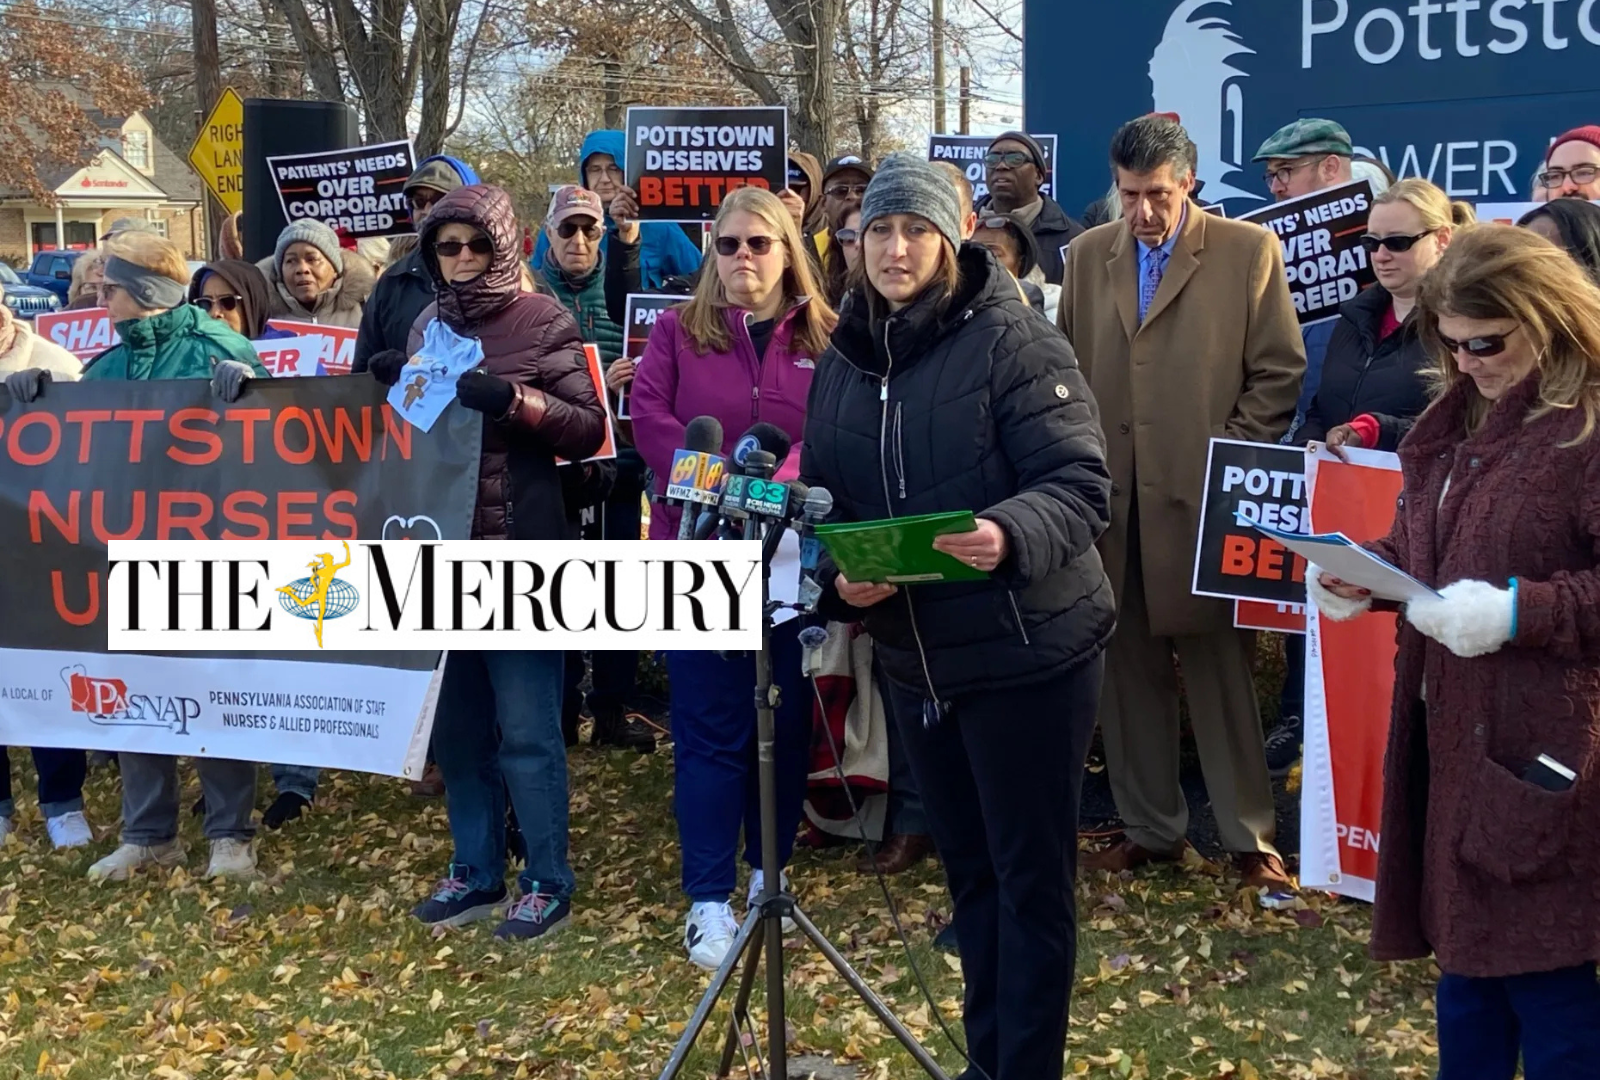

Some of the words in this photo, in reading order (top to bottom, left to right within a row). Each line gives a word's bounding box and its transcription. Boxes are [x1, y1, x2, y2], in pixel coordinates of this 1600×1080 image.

[636, 126, 774, 147] POTTSTOWN
[277, 161, 351, 180] PATIENTS'
[355, 152, 407, 173] NEEDS
[646, 150, 763, 171] DESERVES
[93, 179, 128, 188] Santander
[317, 176, 374, 197] OVER
[289, 193, 407, 217] CORPORAT
[1304, 193, 1368, 227] NEEDS
[0, 406, 412, 466] OTTSTOWN
[672, 455, 697, 484] 69
[669, 485, 691, 498] WFMZ
[28, 490, 358, 544] NURSES
[2, 688, 8, 698] A
[10, 687, 39, 700] LOCAL
[41, 689, 53, 700] OF
[209, 690, 291, 708] PENNSYLVANIA
[293, 695, 352, 713] ASSOCIATION
[354, 699, 364, 713] OF
[366, 700, 386, 716] STAFF
[90, 680, 201, 735] PASNAP
[222, 712, 267, 730] NURSES
[269, 716, 276, 729] &
[278, 717, 311, 733] ALLIED
[313, 721, 380, 739] PROFESSIONALS
